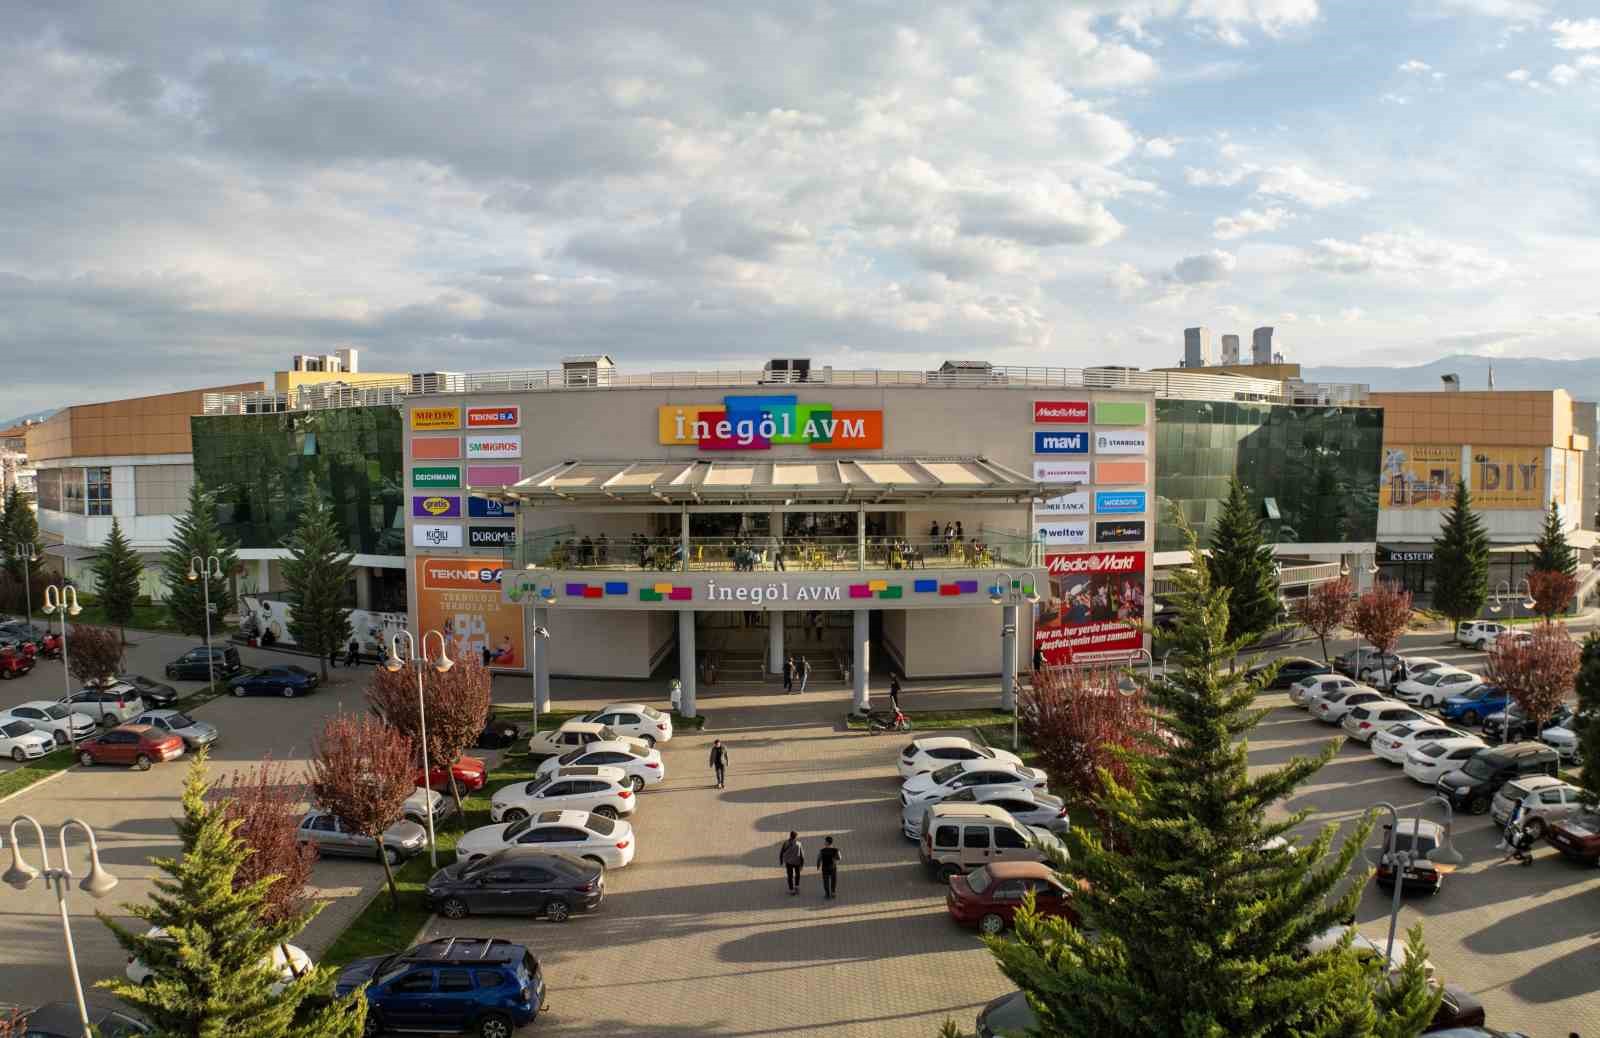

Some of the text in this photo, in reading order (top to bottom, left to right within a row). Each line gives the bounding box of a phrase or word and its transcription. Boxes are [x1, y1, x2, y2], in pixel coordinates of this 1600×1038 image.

[801, 419, 866, 438] AVM
[1043, 434, 1081, 449] mavi
[415, 472, 457, 480] DEICHMANN
[1048, 528, 1084, 537] weltew
[1048, 555, 1134, 572] Media Markt
[708, 580, 841, 604] İnegöl AVM
